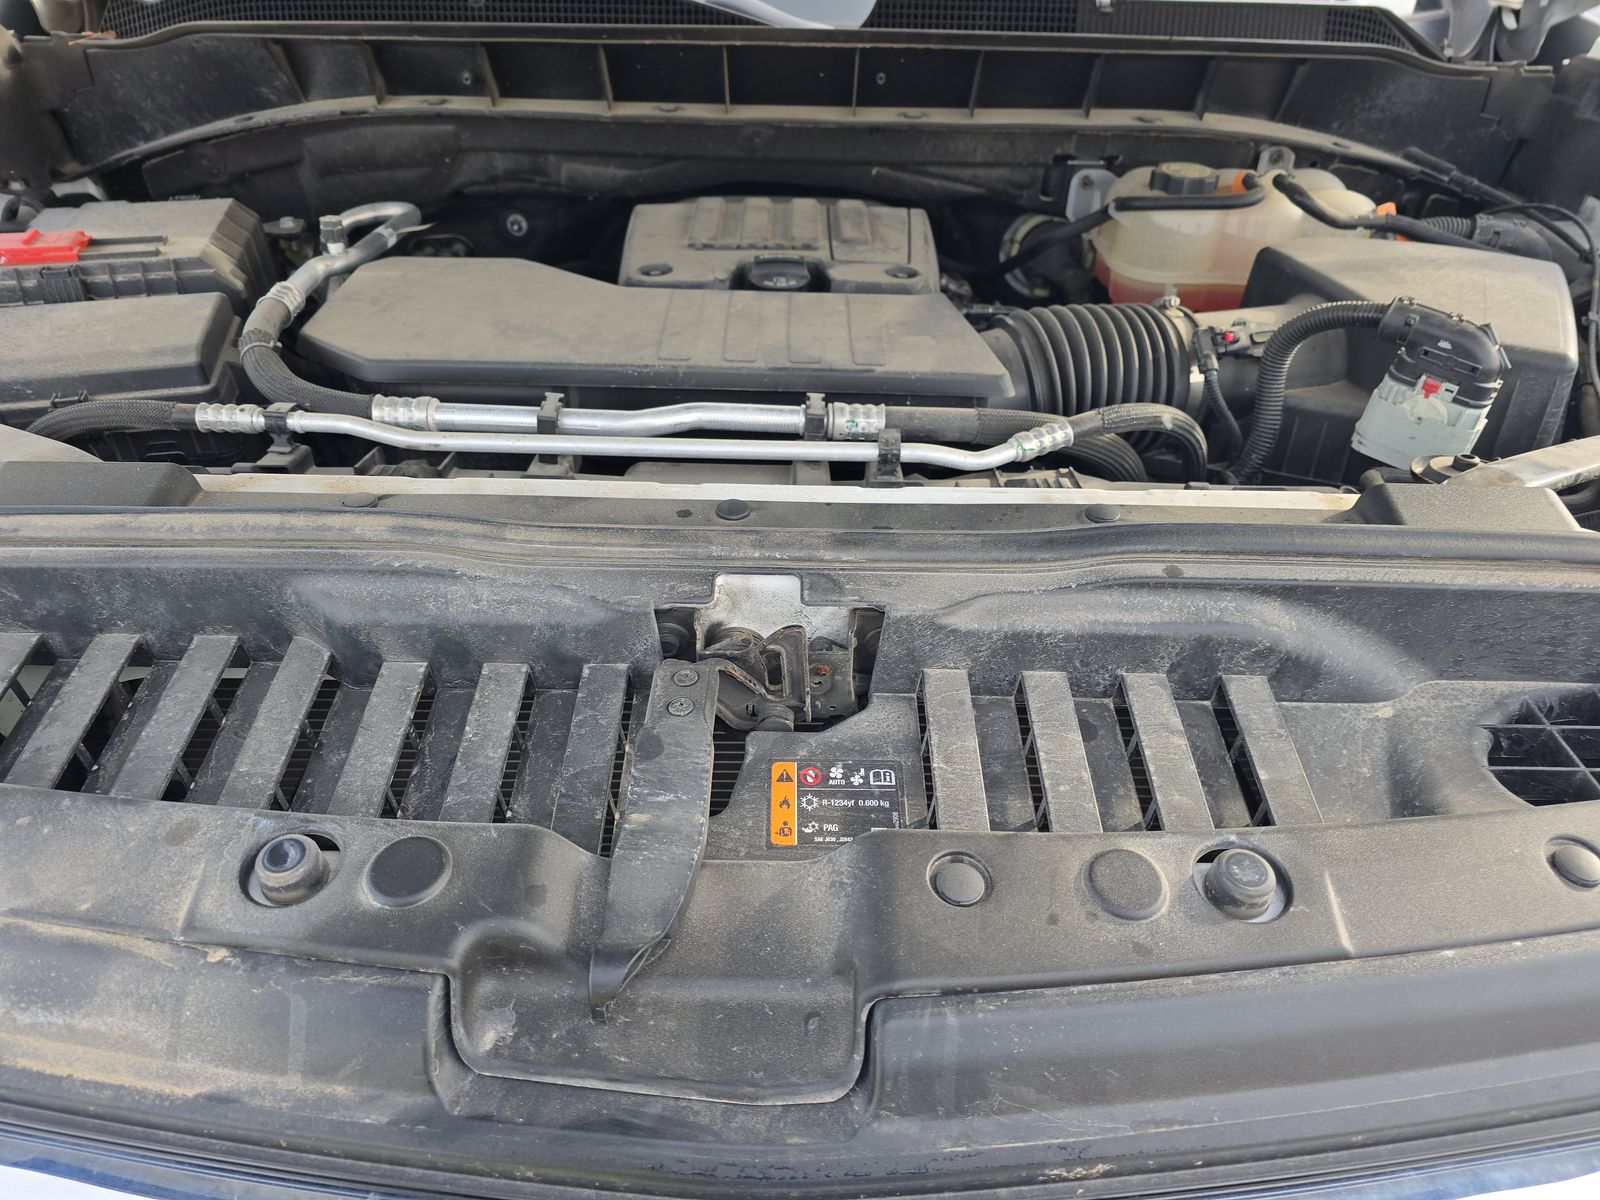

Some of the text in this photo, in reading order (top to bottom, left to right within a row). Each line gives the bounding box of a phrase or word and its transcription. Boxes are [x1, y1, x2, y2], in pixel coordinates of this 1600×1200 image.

[822, 799, 854, 808] R-1234yf
[880, 799, 890, 808] kg
[823, 824, 839, 832] PAG
